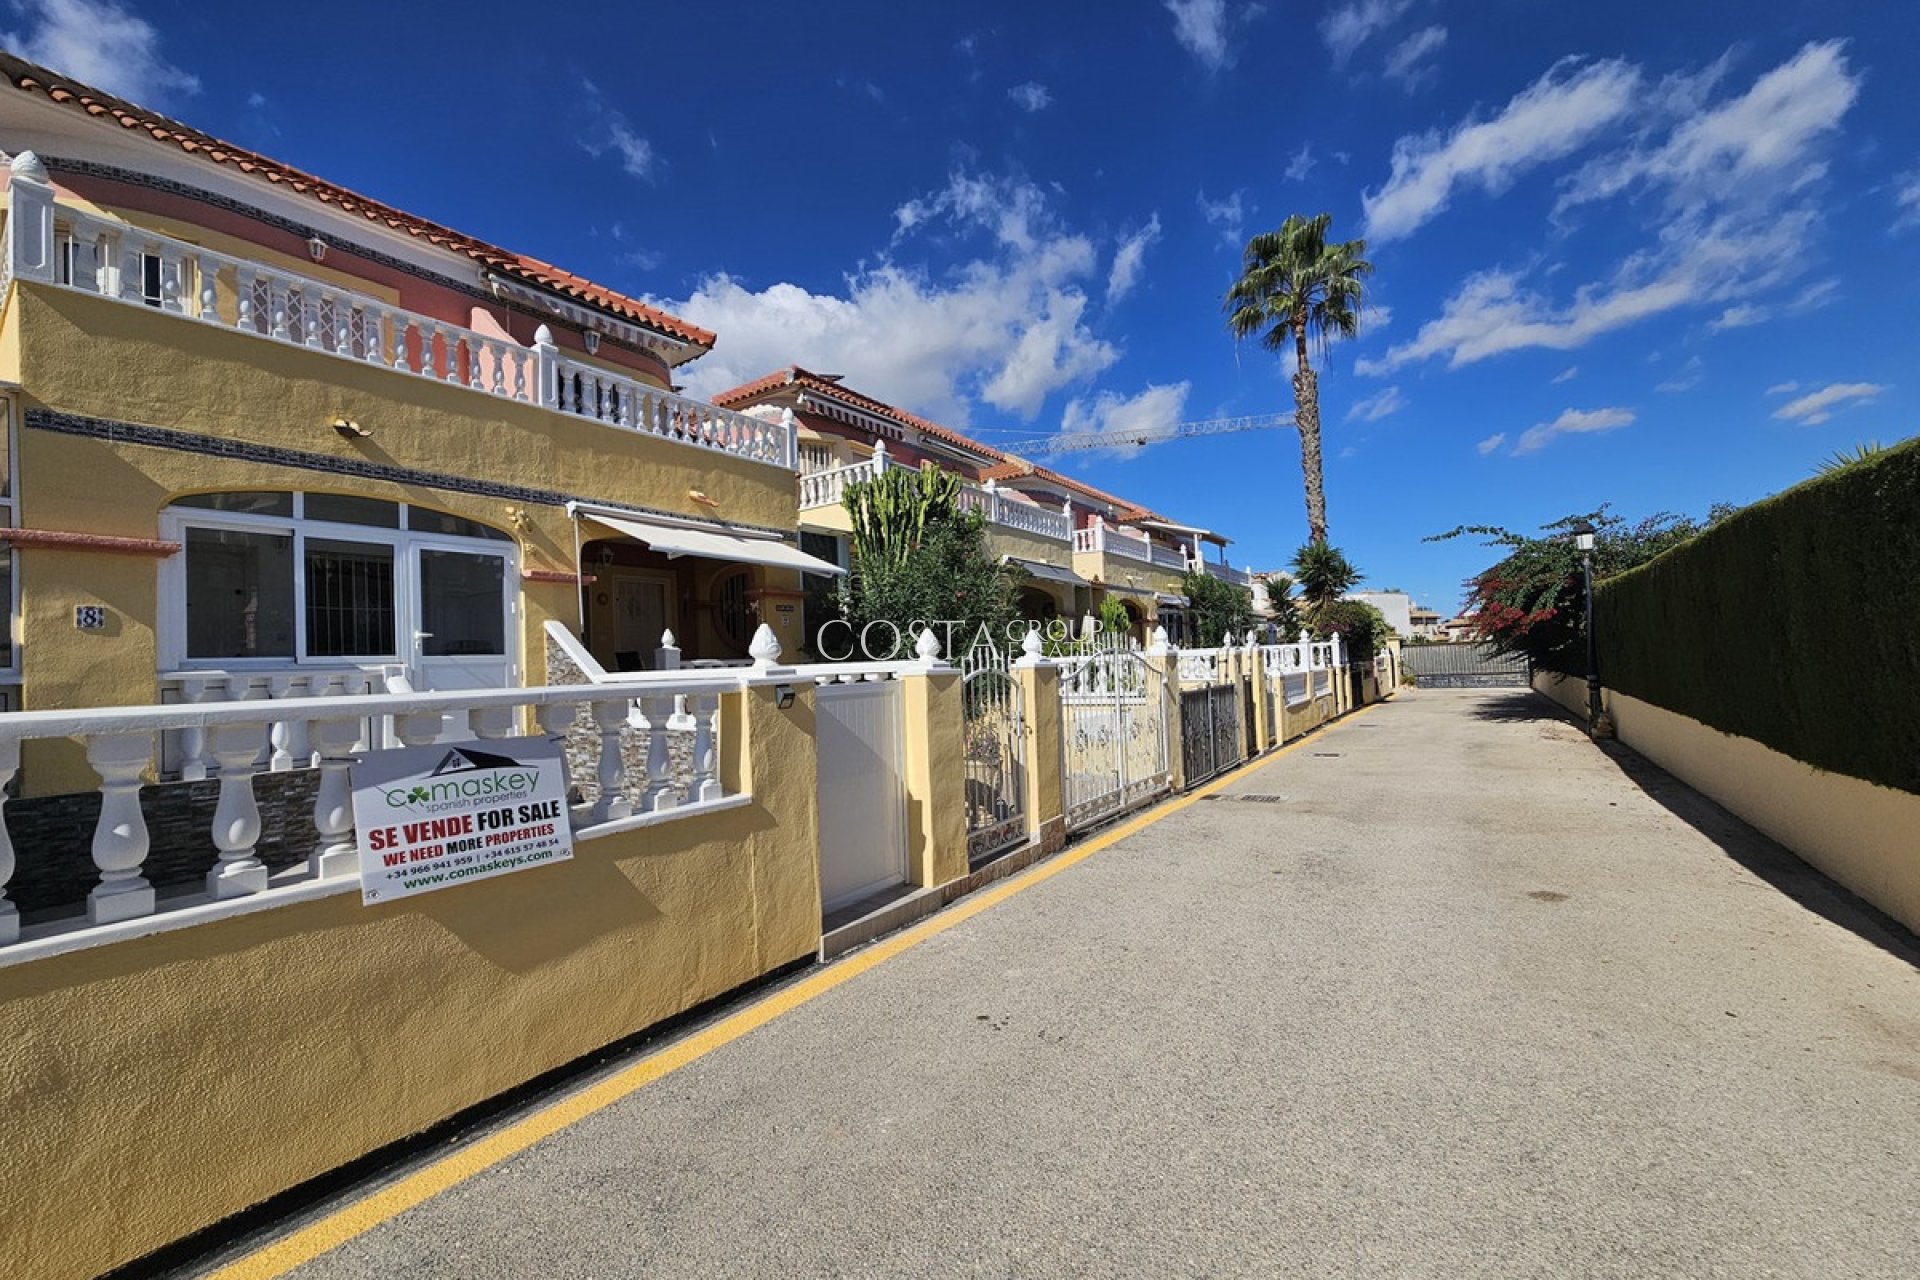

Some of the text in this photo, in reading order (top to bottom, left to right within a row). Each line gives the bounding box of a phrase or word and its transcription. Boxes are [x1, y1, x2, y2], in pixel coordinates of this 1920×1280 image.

[83, 607, 97, 627] 8
[425, 789, 528, 813] spanish properties
[368, 799, 561, 851] SE VENDE FOR SALE
[383, 823, 555, 868] WE NEED MORE PROPERTIES
[386, 868, 408, 880] +34
[410, 863, 431, 876] 966
[432, 859, 452, 871] 941
[454, 855, 473, 866] 959
[484, 849, 503, 861] +34
[403, 849, 554, 890] www.comaskeys.com
